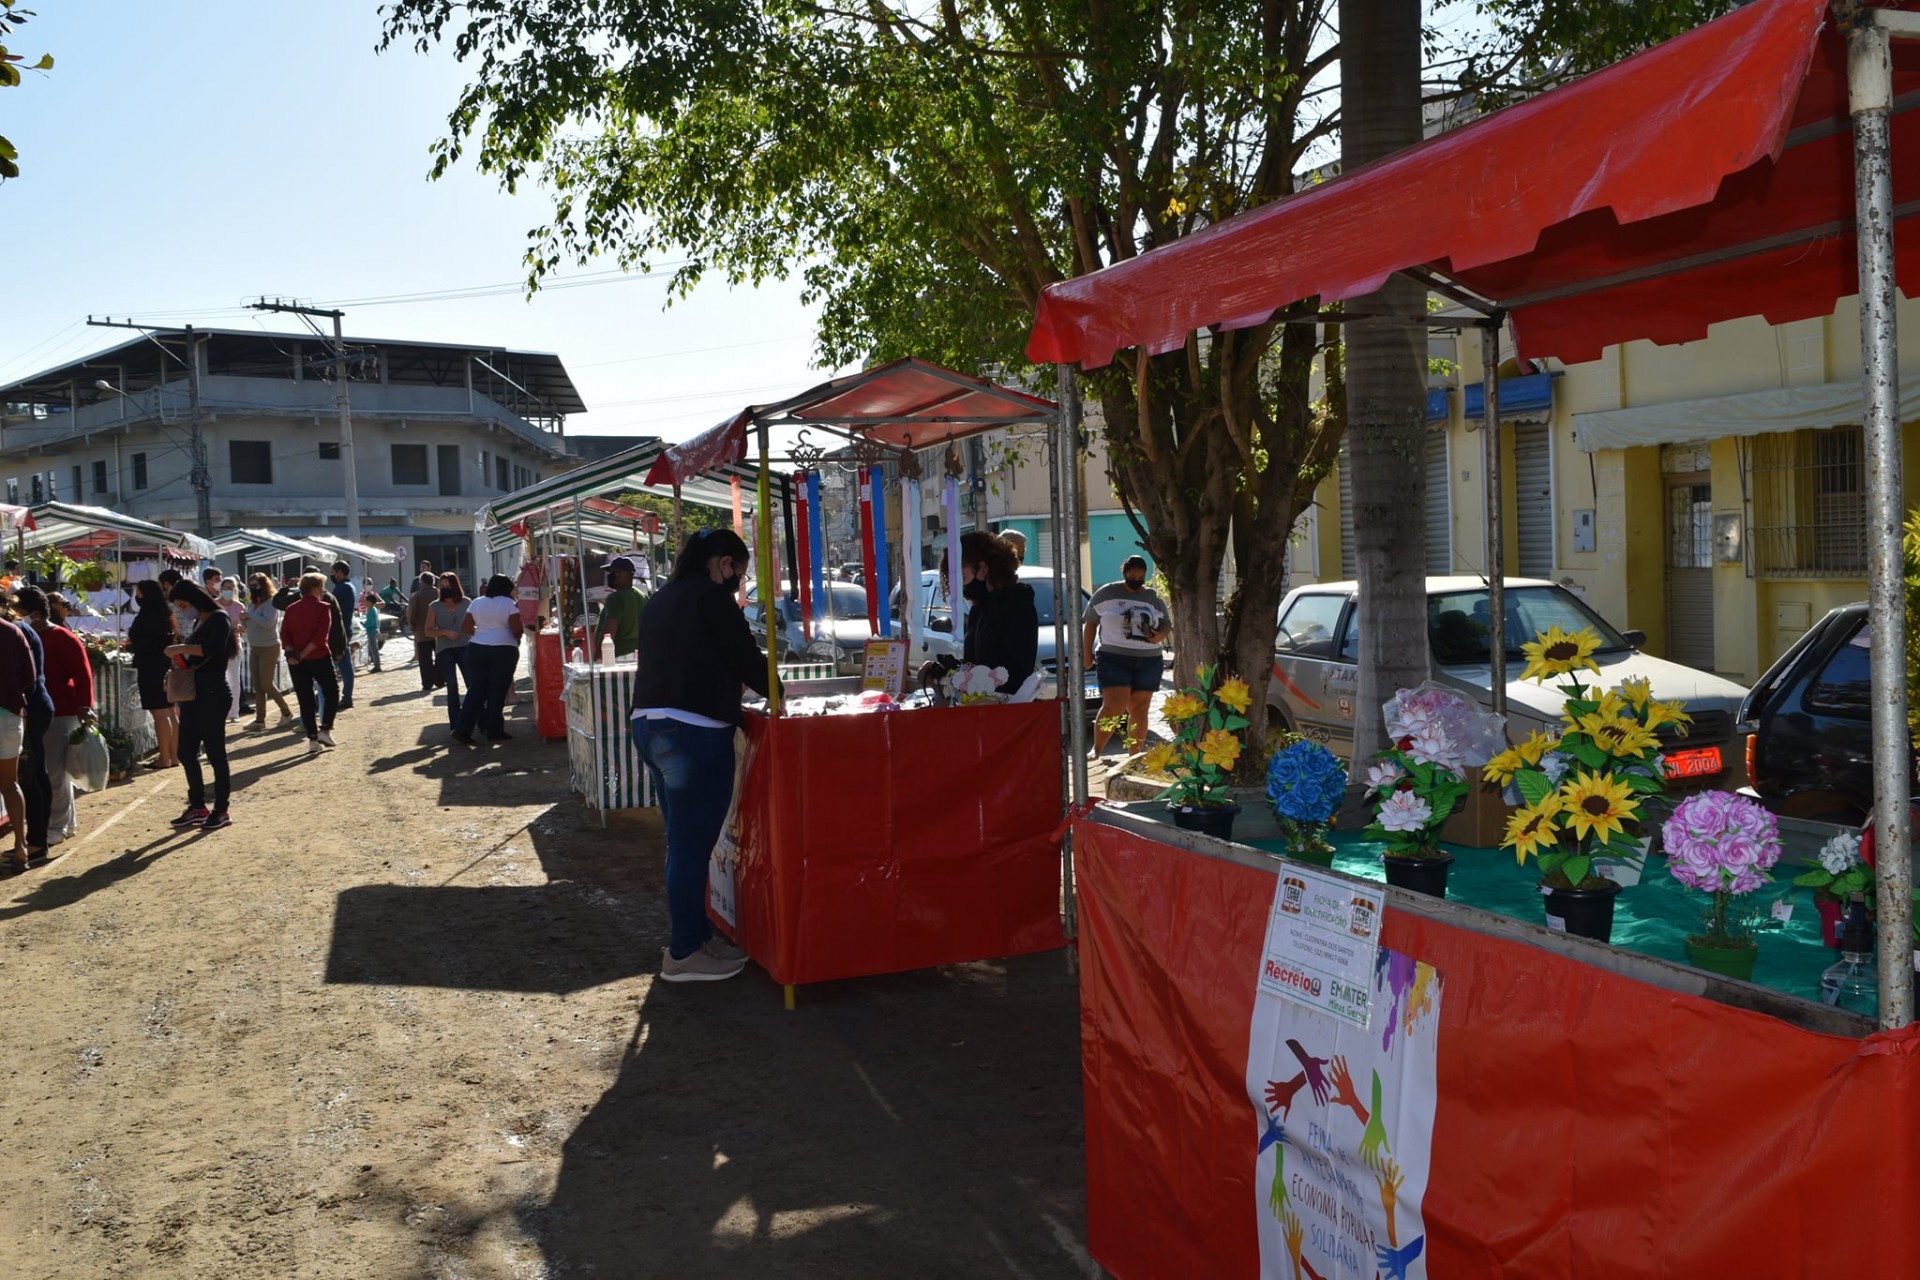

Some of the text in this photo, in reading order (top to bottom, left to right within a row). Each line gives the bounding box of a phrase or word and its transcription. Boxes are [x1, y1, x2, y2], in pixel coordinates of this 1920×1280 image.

[1687, 757, 1718, 773] 2004
[1265, 960, 1310, 991] Recreio
[1292, 1173, 1338, 1225] ECONOMIA
